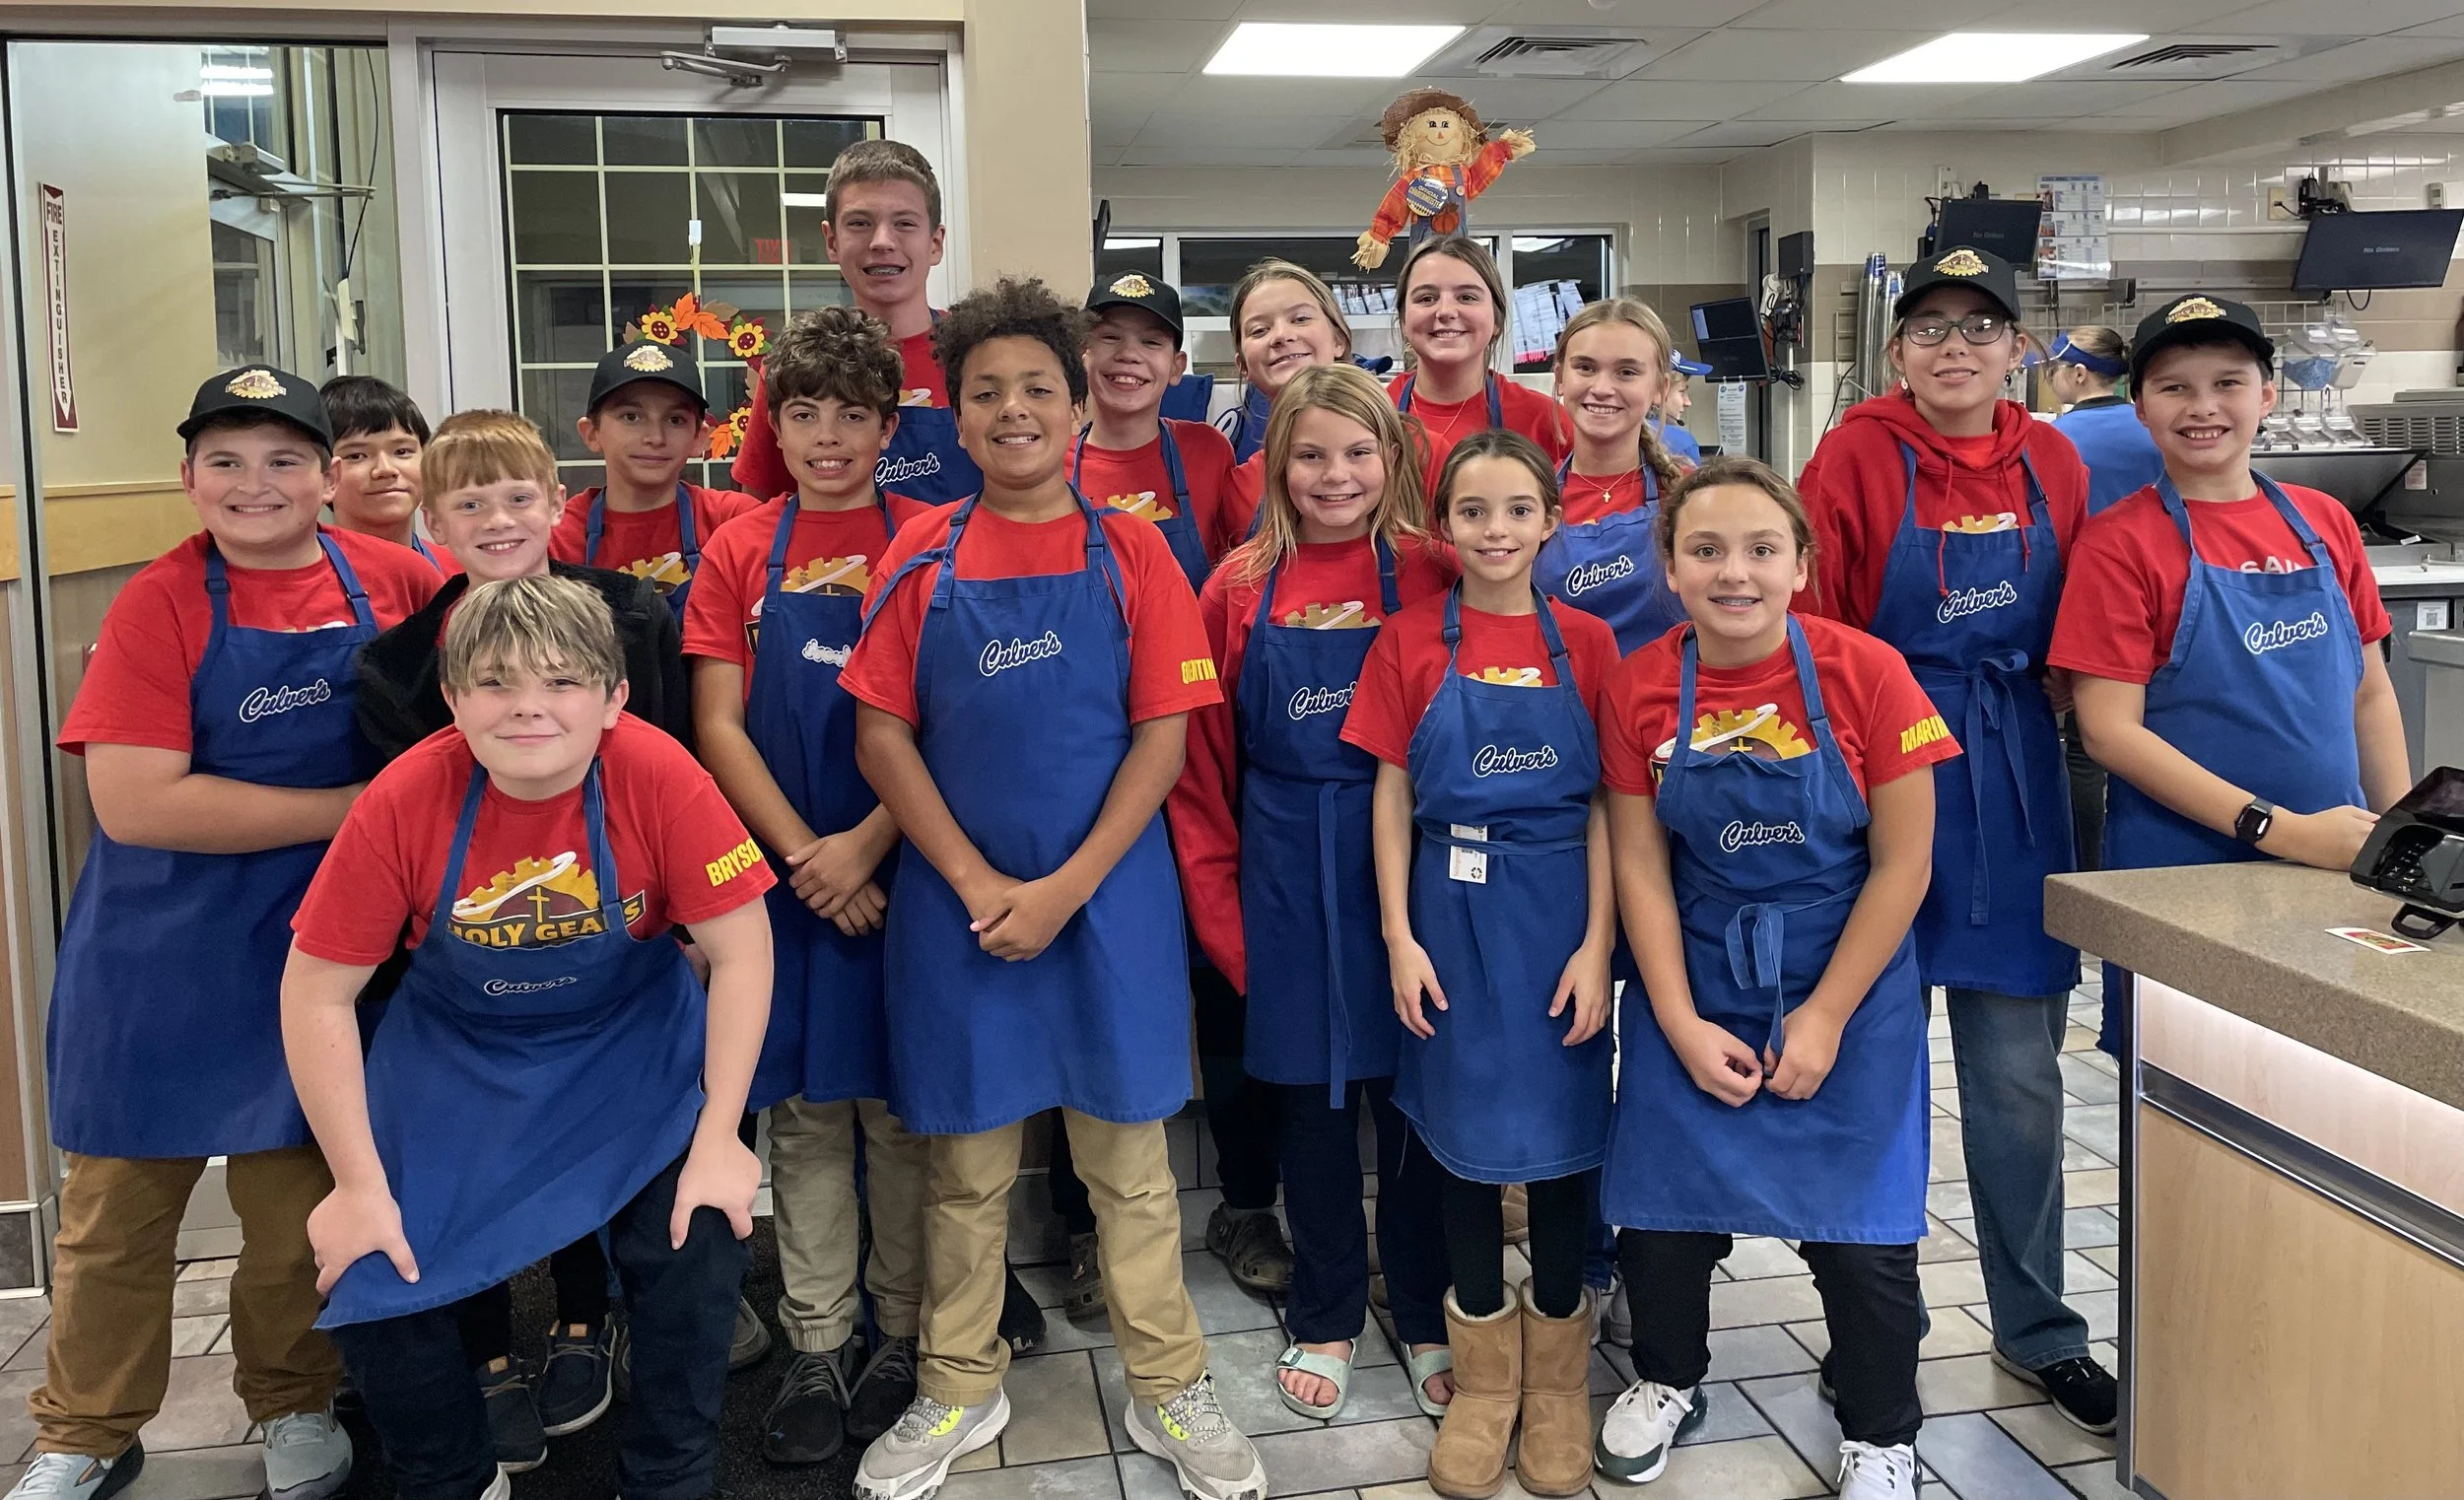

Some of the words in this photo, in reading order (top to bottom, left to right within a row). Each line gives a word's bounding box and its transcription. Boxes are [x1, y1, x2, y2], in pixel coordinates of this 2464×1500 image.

[46, 201, 62, 225] FIRE
[52, 230, 67, 404] EXTINGUISHER
[874, 452, 940, 487] Culver's
[1566, 555, 1634, 597] Culver's
[1938, 582, 2018, 624] Culver's
[2245, 612, 2328, 654] Culver's
[980, 631, 1062, 677] Culver's
[240, 678, 331, 722] Culver's
[1288, 681, 1357, 720] Culver'
[1472, 744, 1558, 778] Culver's
[1720, 820, 1806, 852] Culver's
[535, 901, 641, 941] GEAS
